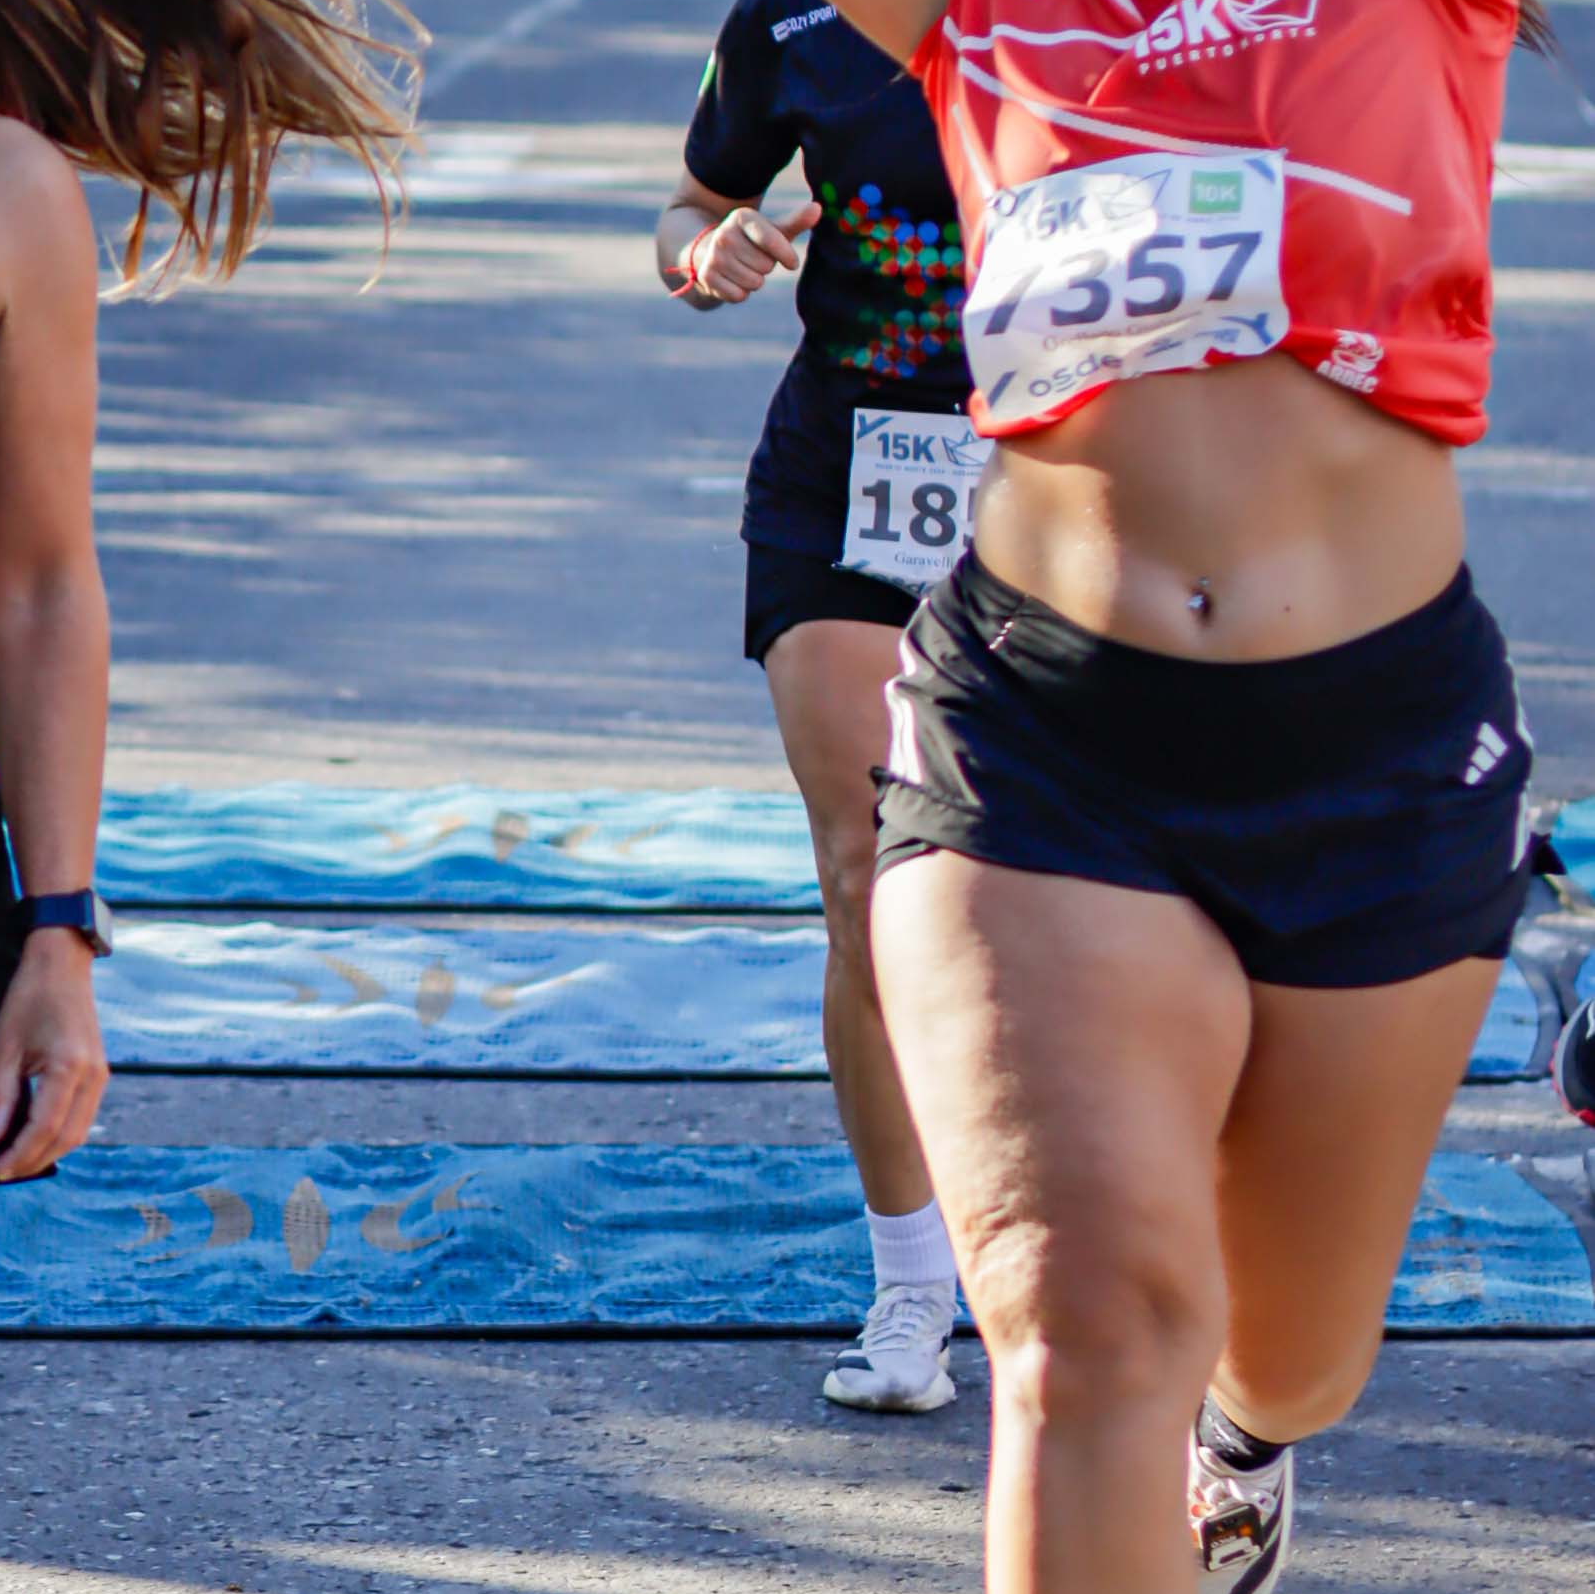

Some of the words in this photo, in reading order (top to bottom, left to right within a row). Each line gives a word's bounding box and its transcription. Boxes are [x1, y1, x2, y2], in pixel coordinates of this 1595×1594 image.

[1138, 44, 1235, 76] PUERTO
[1194, 182, 1238, 202] 10K
[983, 231, 1263, 336] 7357
[1027, 353, 1123, 398] osde
[877, 432, 936, 464] 15K
